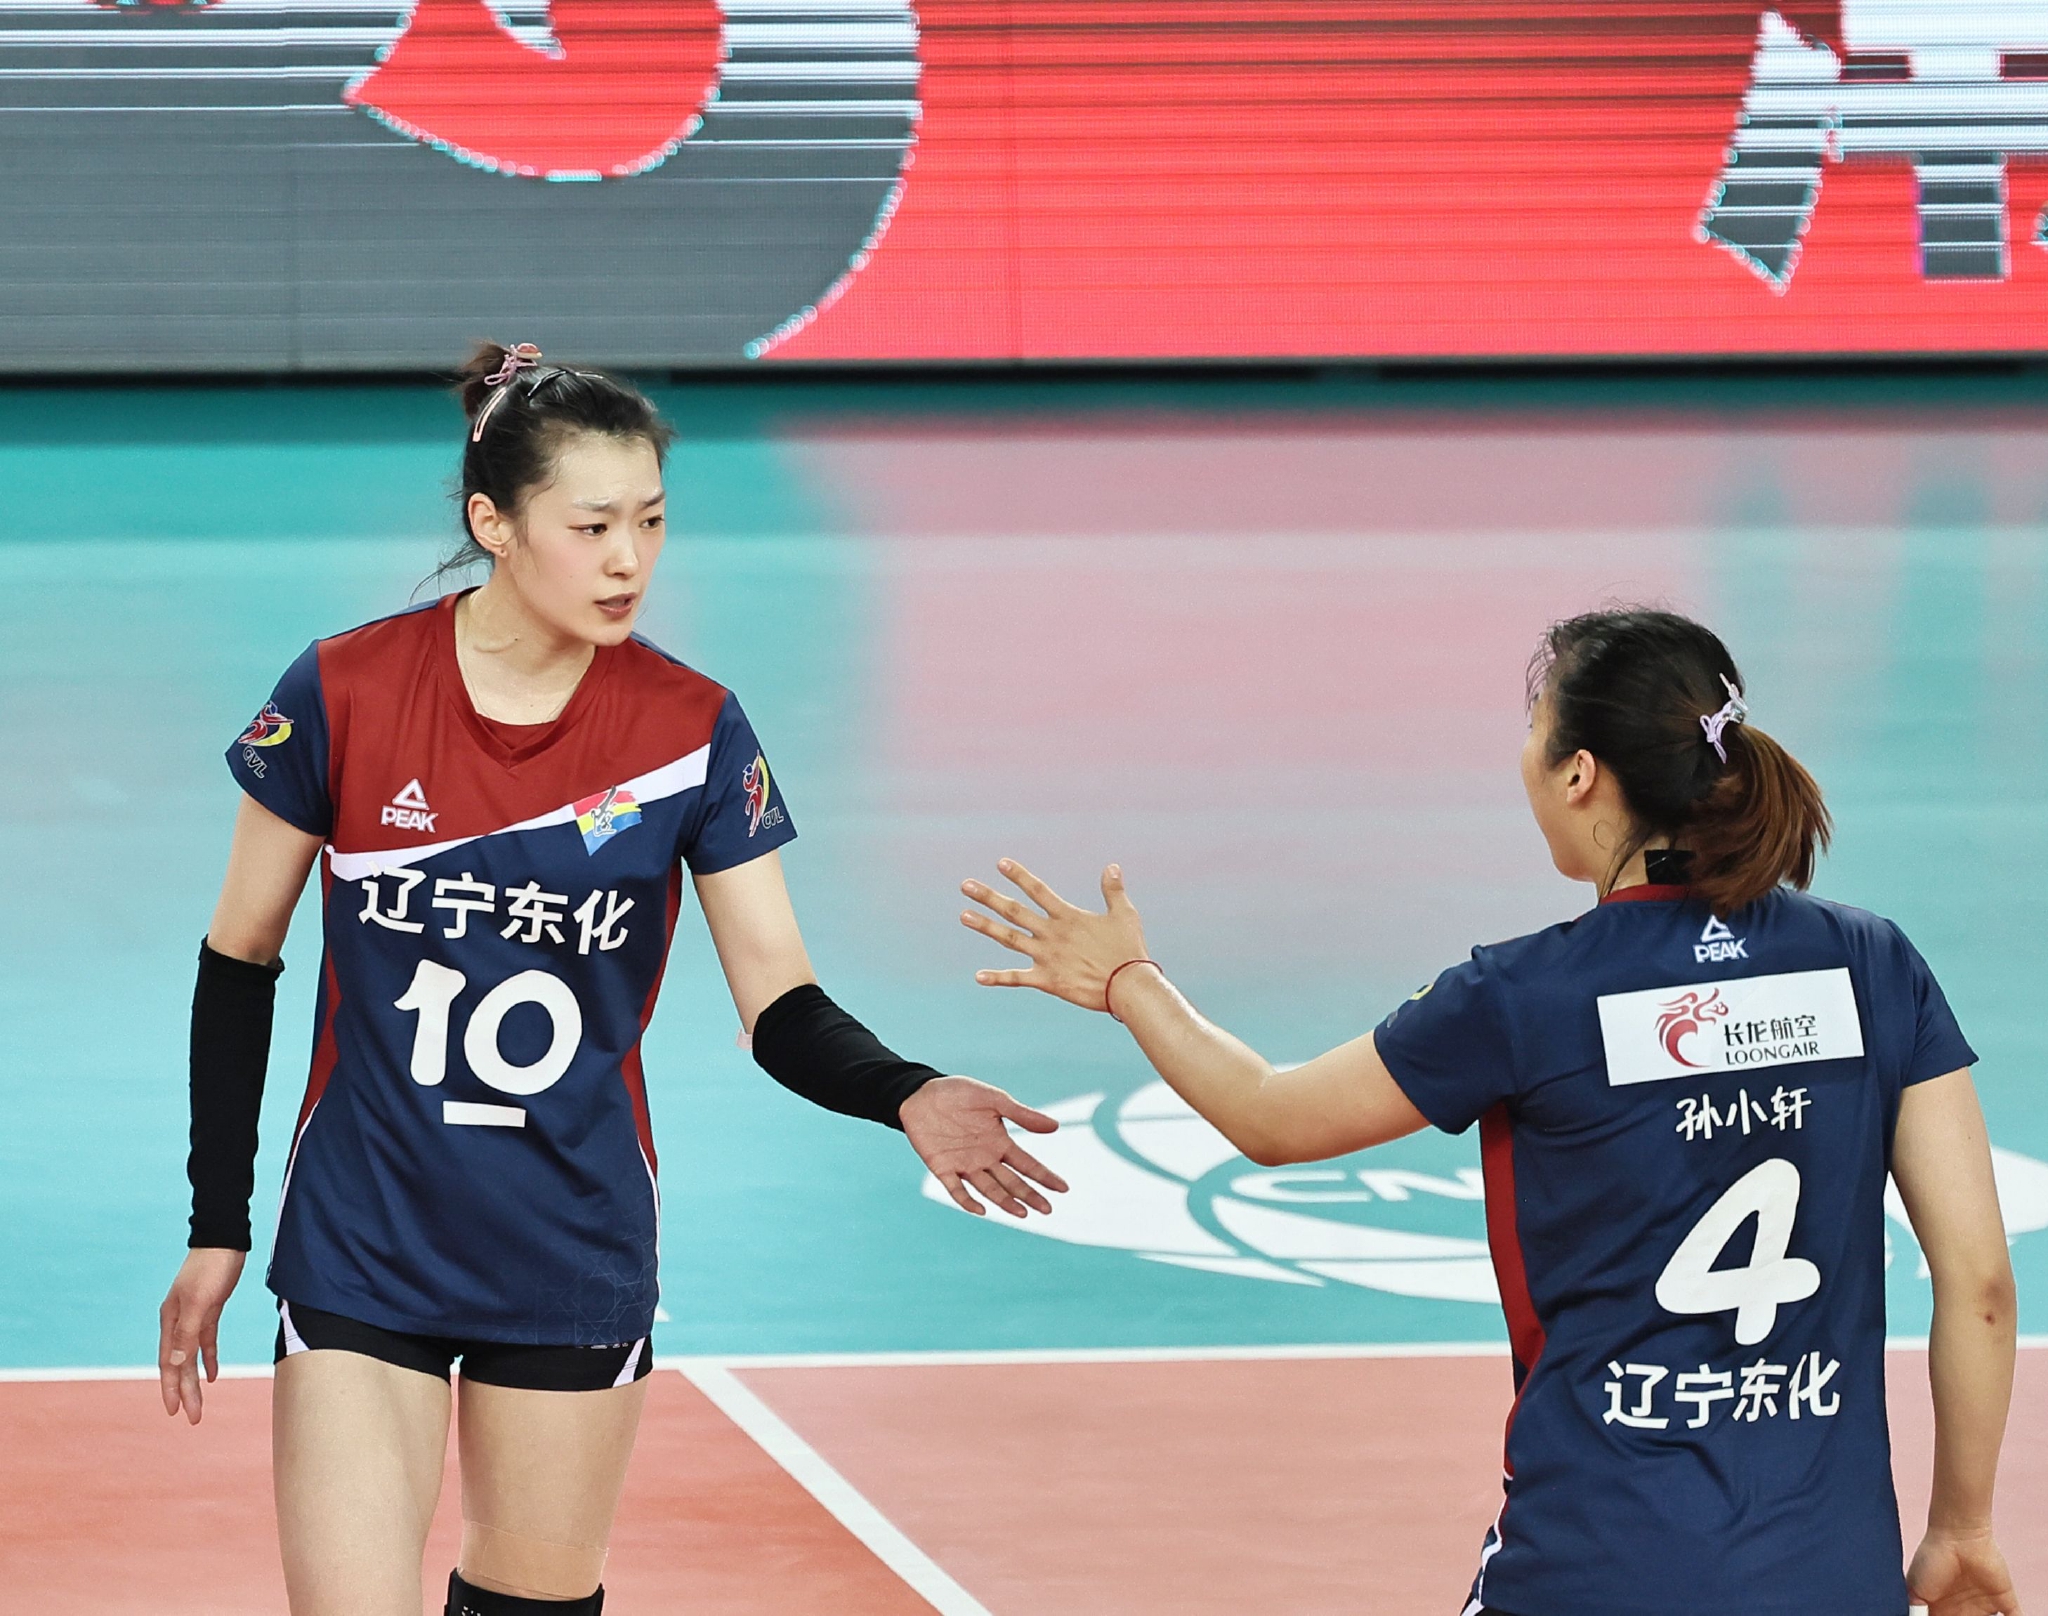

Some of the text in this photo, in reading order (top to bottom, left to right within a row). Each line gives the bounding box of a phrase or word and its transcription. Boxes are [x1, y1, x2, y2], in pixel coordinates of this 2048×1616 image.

[243, 745, 267, 779] CVL
[381, 804, 439, 834] PEAK
[762, 806, 785, 830] CVL
[358, 860, 636, 956] 辽宁东化
[1692, 937, 1750, 963] PEAK
[393, 959, 583, 1096] 10
[1723, 1014, 1819, 1047] 长龙航空
[1725, 1041, 1821, 1066] LOONGAIR
[1675, 1085, 1813, 1142] 孙小轩
[1655, 1158, 1821, 1345] 4
[1602, 1351, 1842, 1430] 辽宁东化
